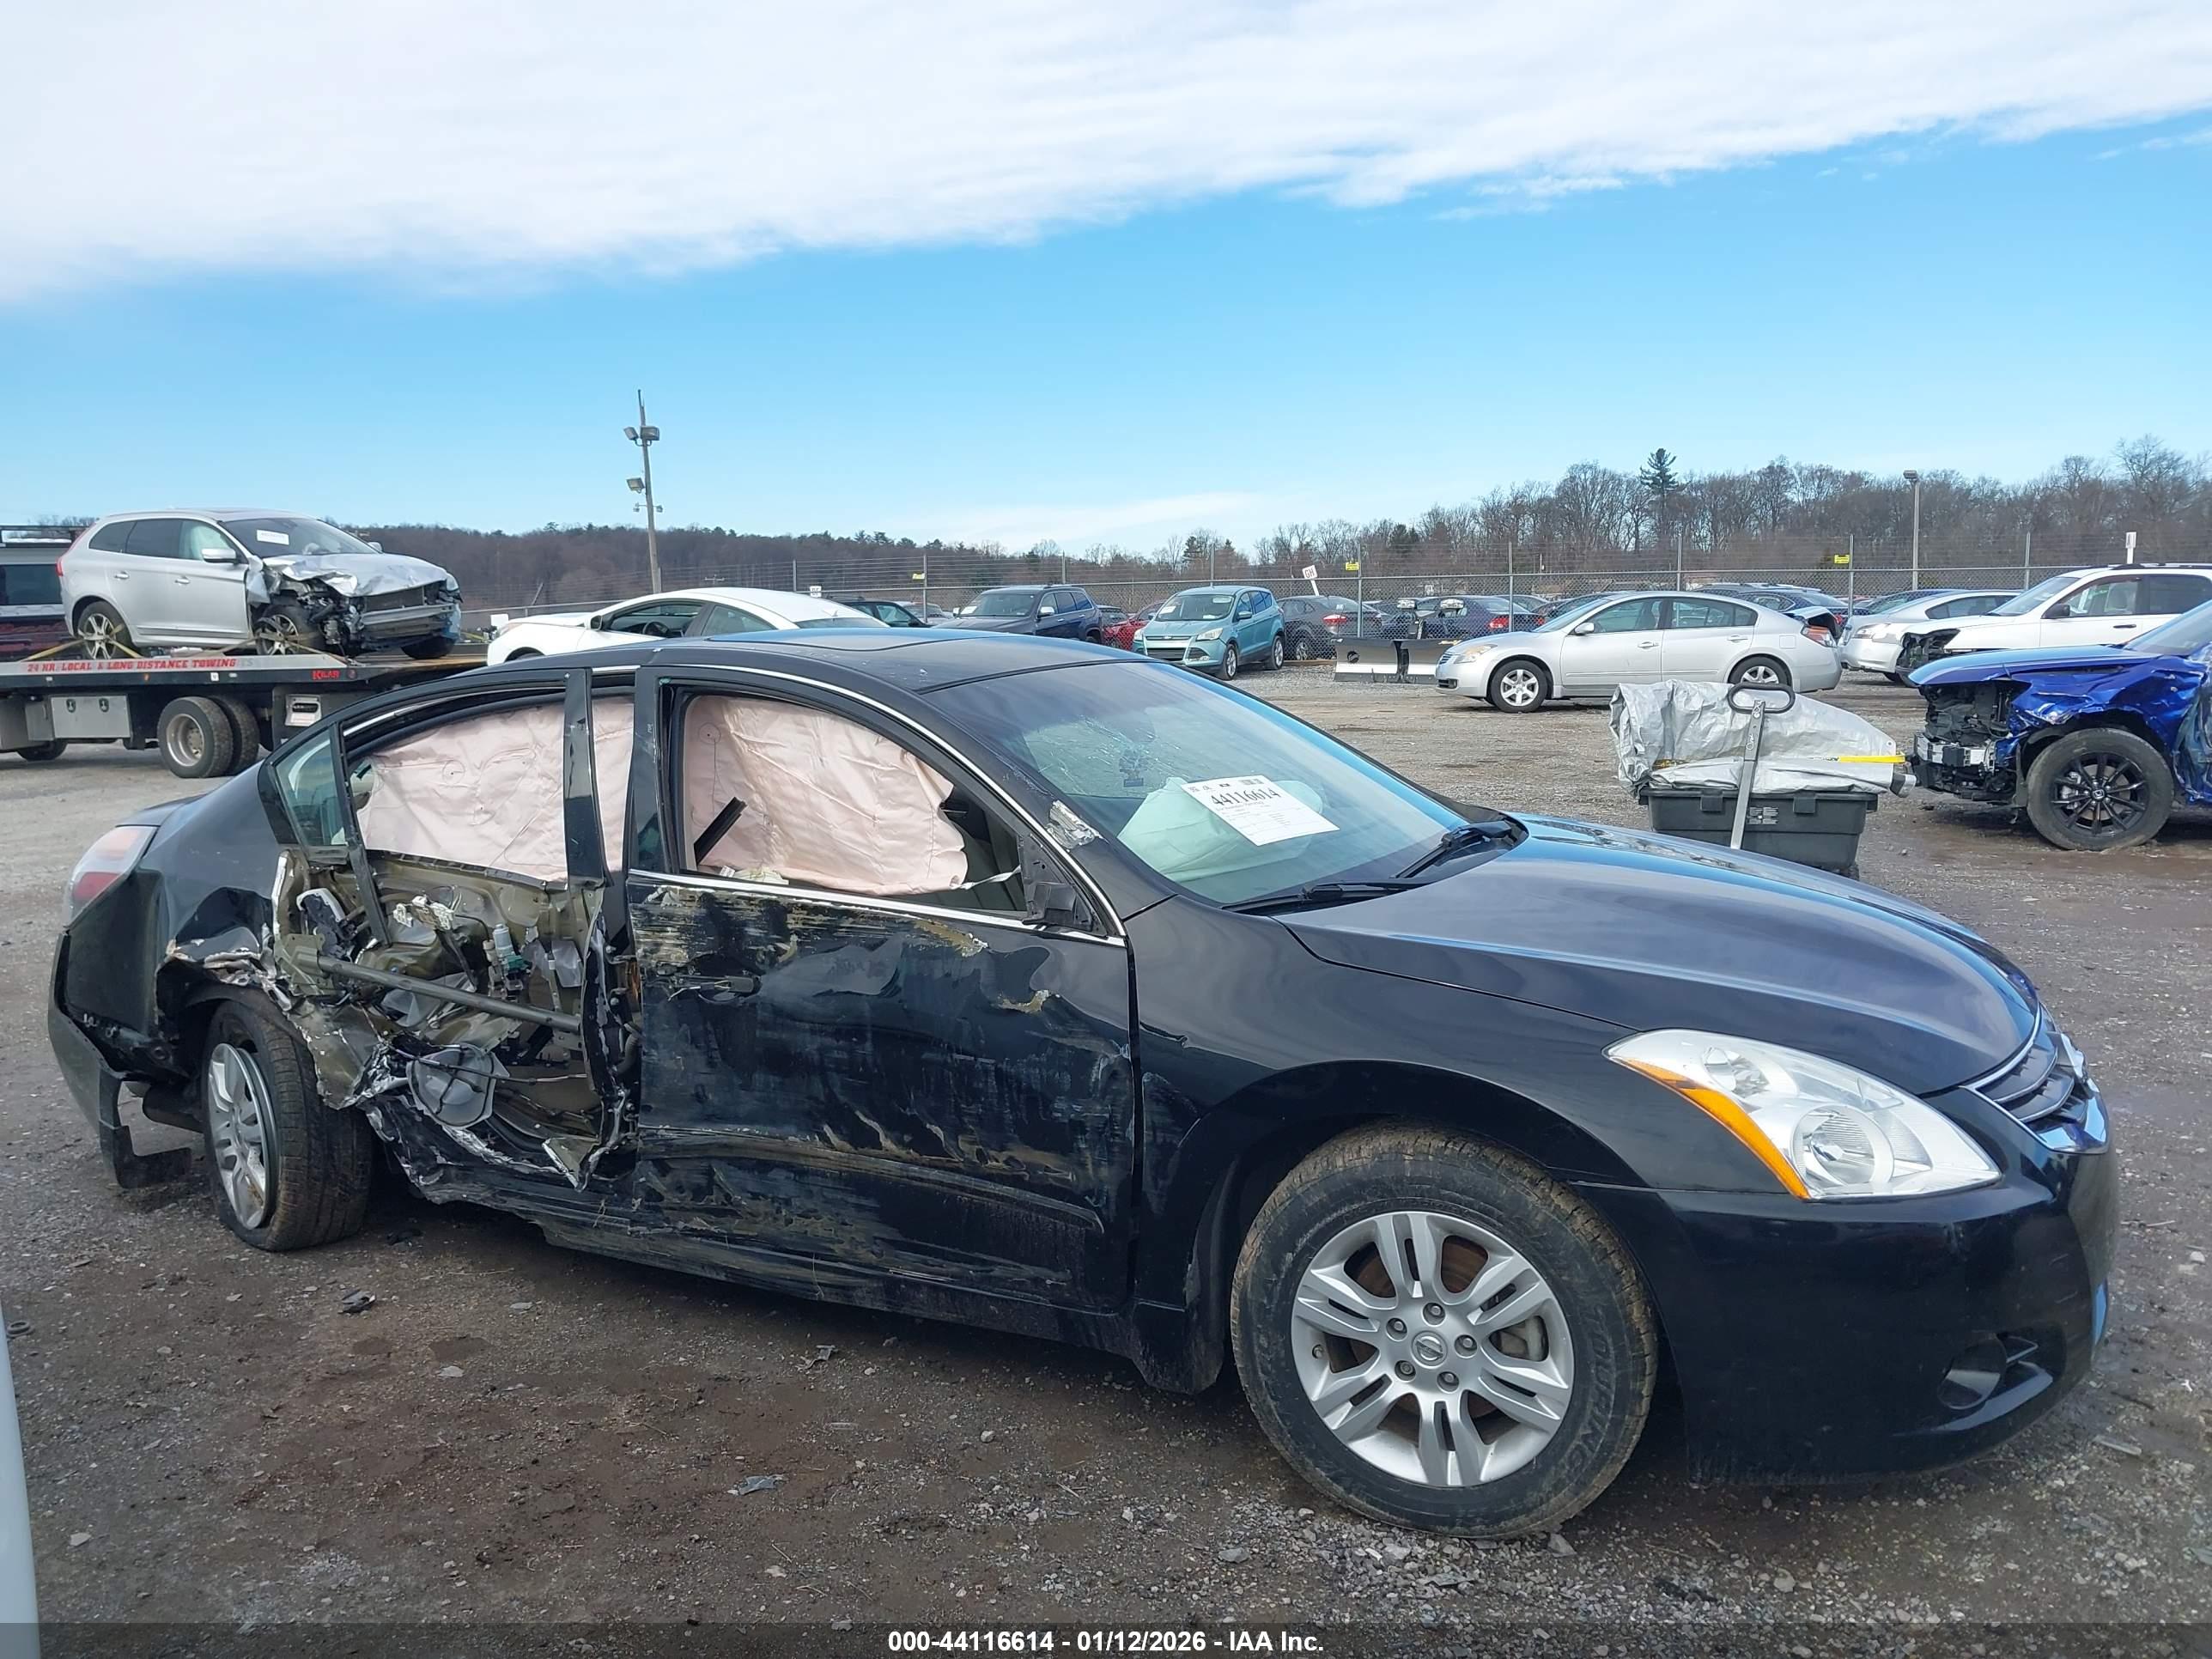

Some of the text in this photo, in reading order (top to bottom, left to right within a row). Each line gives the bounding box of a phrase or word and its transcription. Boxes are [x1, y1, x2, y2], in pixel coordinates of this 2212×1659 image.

[1304, 568, 1315, 578] GH
[62, 662, 92, 671] LOCAL
[107, 661, 133, 670] LONG
[137, 659, 189, 669] DISTANCE
[192, 659, 237, 667] TOWING
[1211, 787, 1280, 805] 44116614
